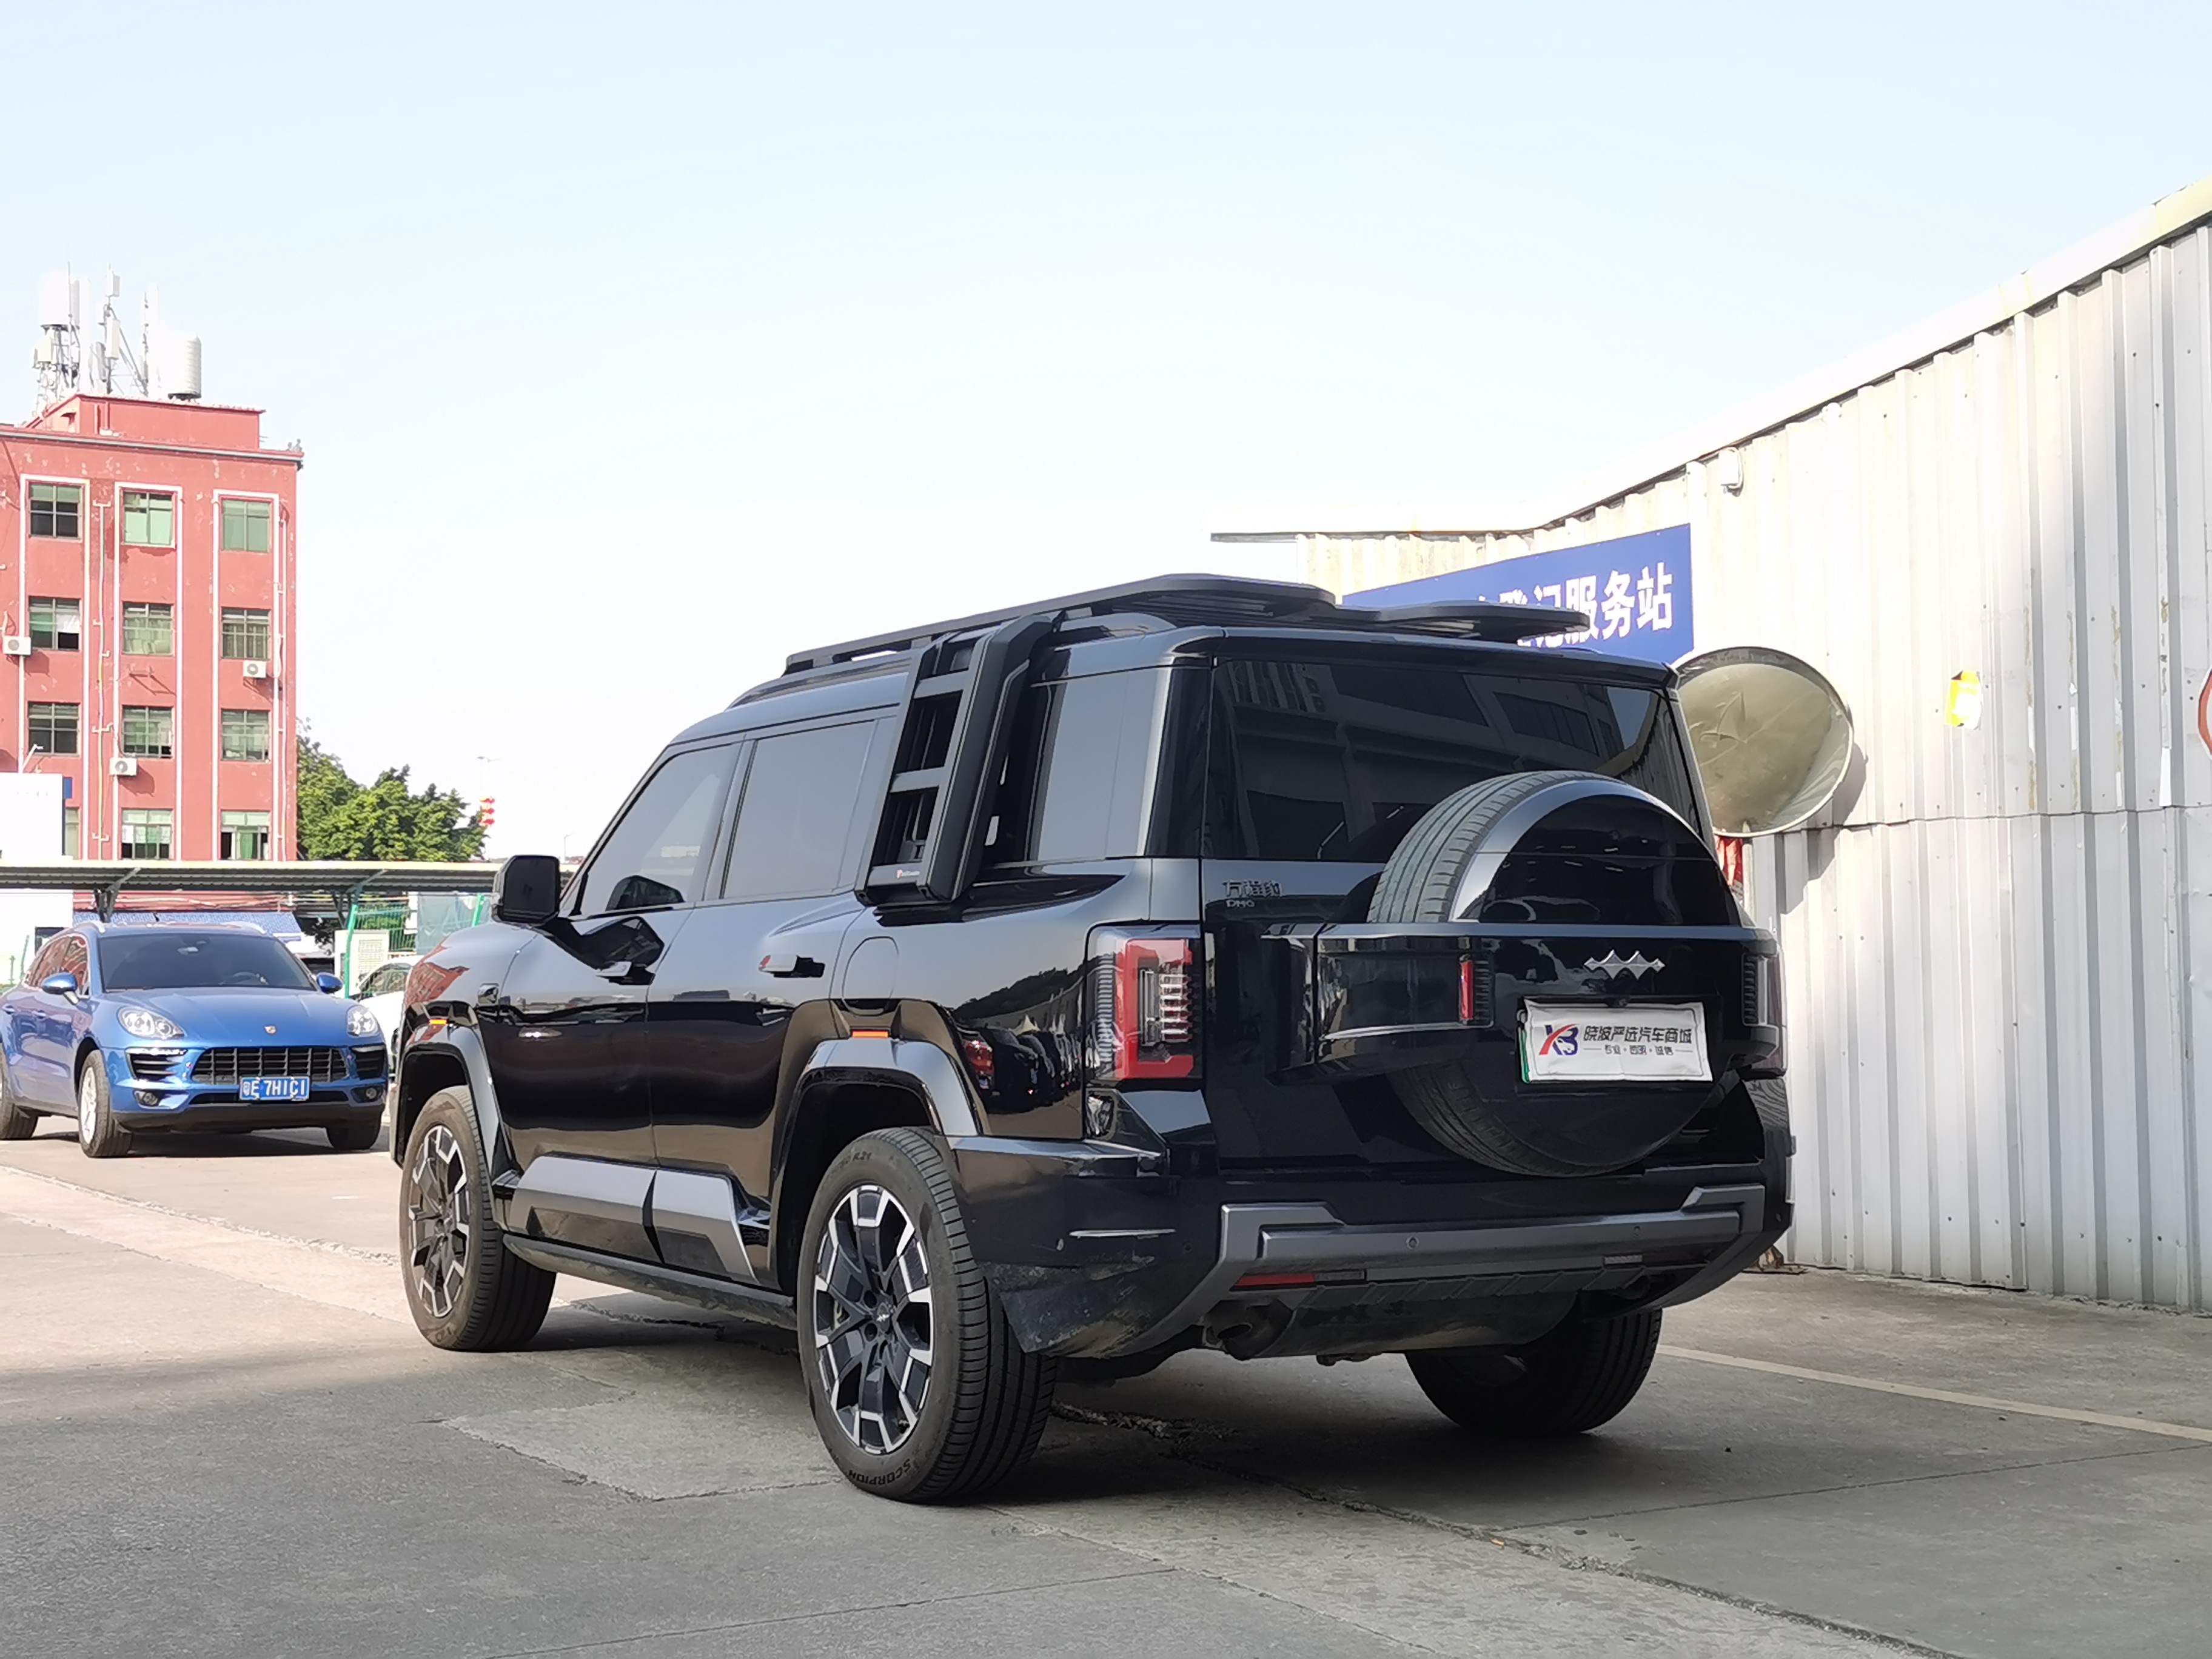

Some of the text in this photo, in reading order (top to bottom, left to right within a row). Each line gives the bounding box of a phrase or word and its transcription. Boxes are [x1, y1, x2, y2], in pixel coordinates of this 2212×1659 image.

[1225, 899, 1255, 908] DMO
[1583, 1025, 1692, 1044] 晓波严选汽车商城
[849, 1458, 911, 1485] SCORPION
